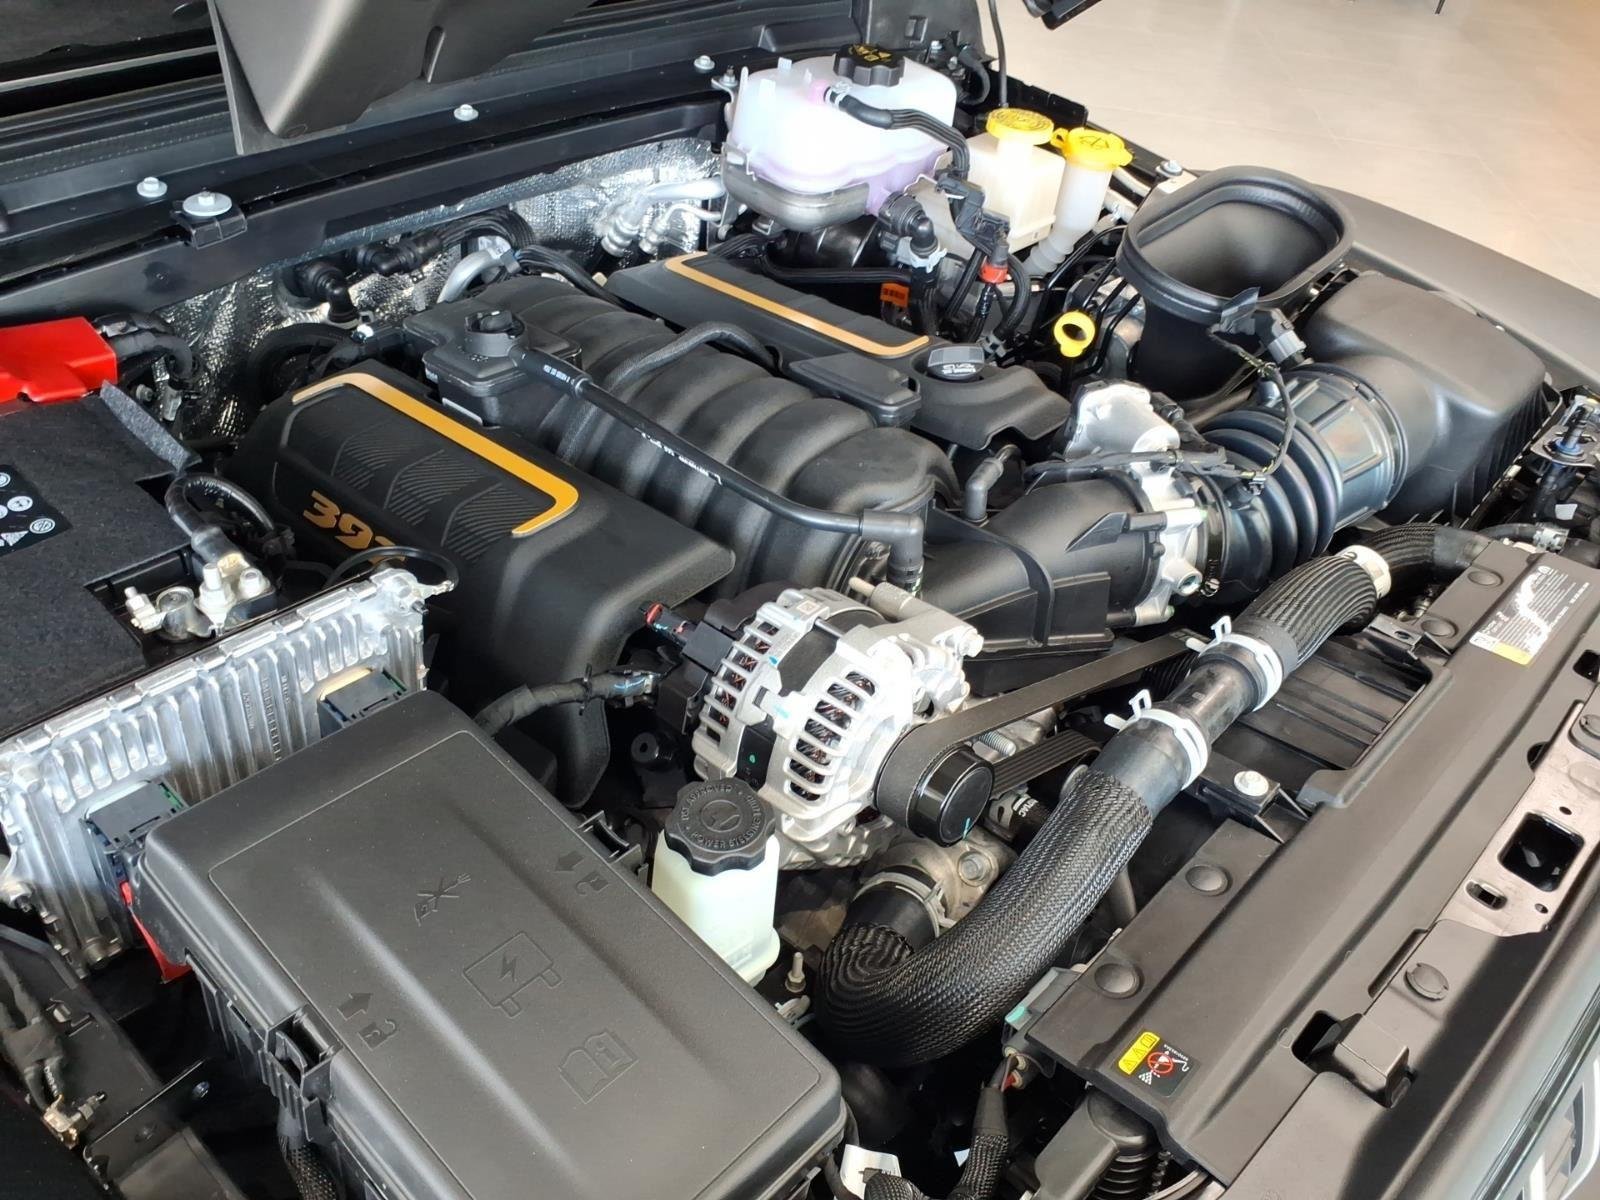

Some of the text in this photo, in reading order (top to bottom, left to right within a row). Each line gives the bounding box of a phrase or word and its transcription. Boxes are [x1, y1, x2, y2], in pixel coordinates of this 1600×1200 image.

[687, 784, 733, 806] APPROVED
[690, 831, 726, 849] POWER
[728, 816, 762, 848] STEERING
